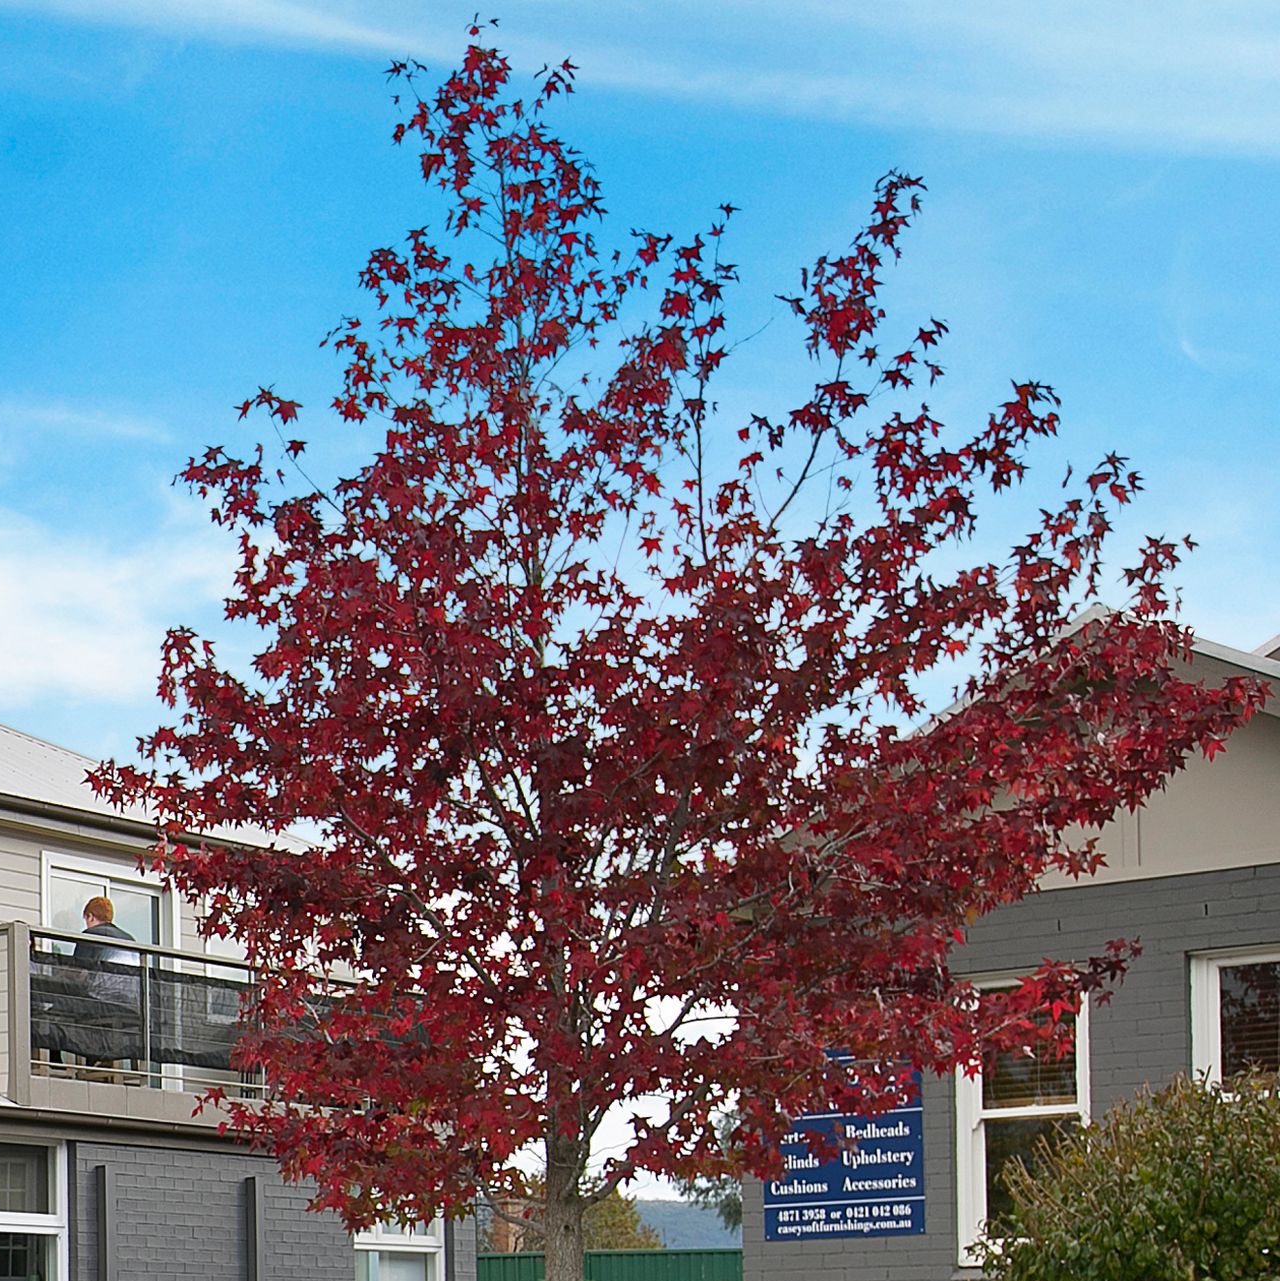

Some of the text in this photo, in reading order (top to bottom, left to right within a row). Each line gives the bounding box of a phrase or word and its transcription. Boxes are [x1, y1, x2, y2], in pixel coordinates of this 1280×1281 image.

[846, 1121, 910, 1139] Redheads
[842, 1149, 914, 1169] Upholstery
[771, 1180, 828, 1196] Cushions
[843, 1174, 917, 1192] Accessories
[777, 1204, 912, 1222] 4871 3958 or 0421 042 086
[777, 1219, 912, 1236] caseysoftfurnishings.com.au
